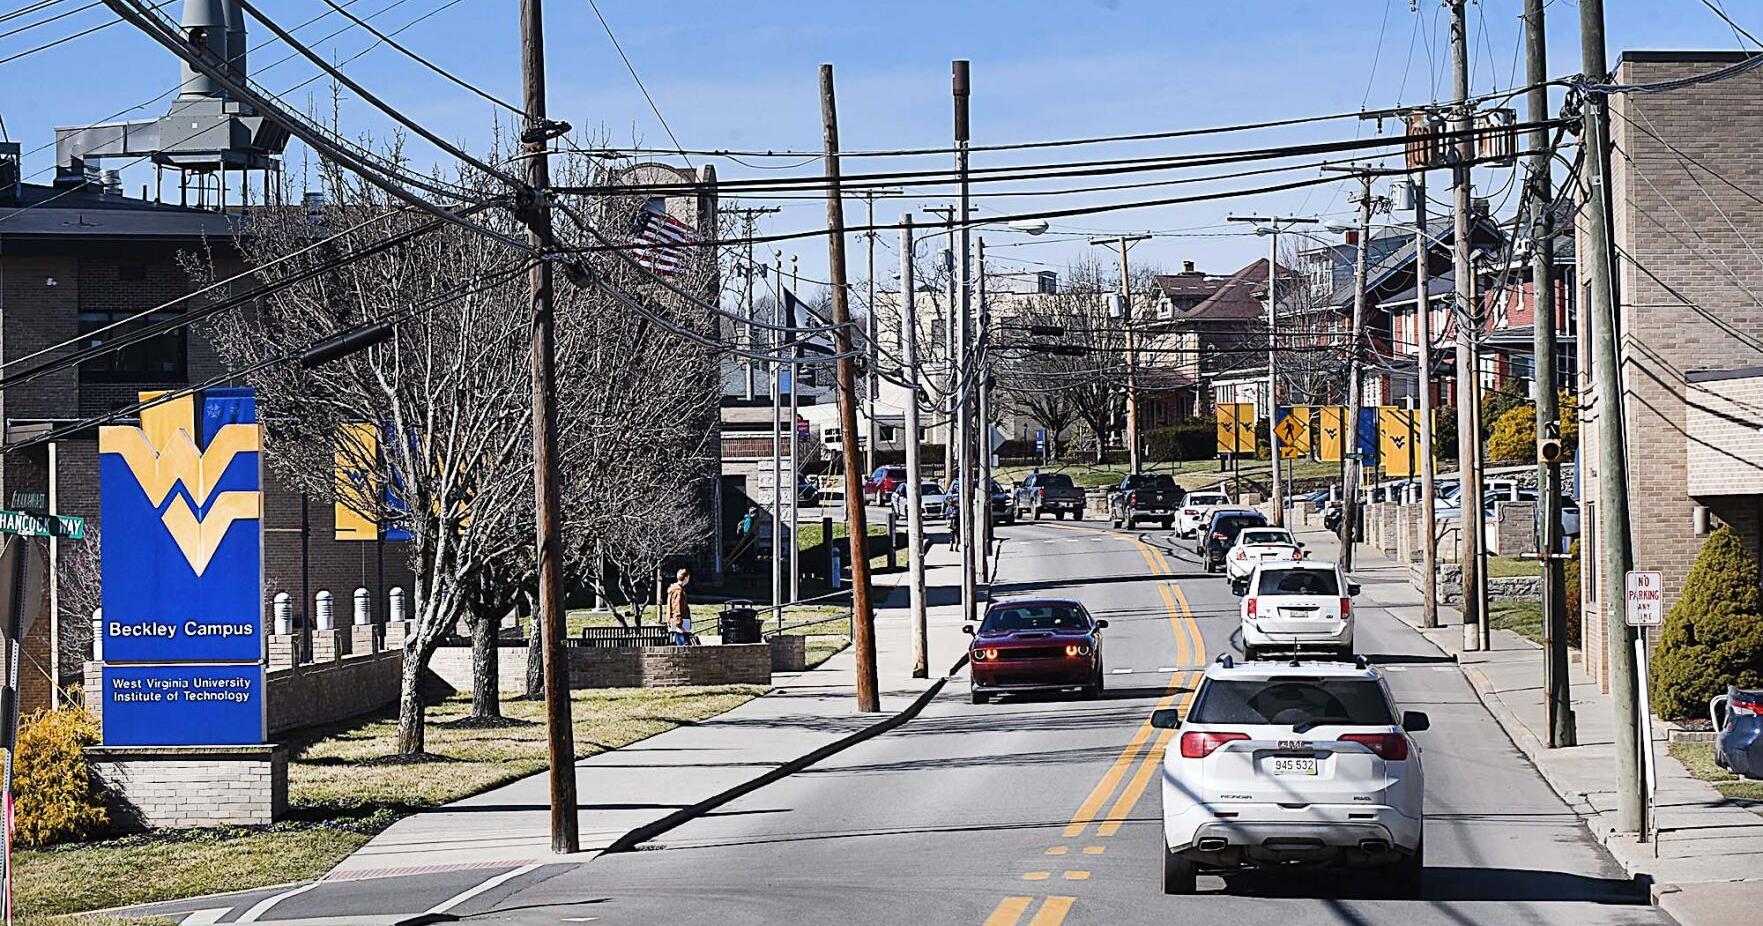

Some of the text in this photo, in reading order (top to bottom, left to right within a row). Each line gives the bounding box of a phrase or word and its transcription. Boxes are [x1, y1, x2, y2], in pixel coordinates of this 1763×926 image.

[0, 513, 82, 535] HANCOCK WAY
[1638, 577, 1650, 587] NO
[1629, 590, 1659, 600] PARKING
[109, 622, 253, 639] Beckley Campus
[112, 677, 251, 690] West Virginia University
[114, 691, 250, 703] Institute of Technology
[1296, 760, 1314, 770] 532
